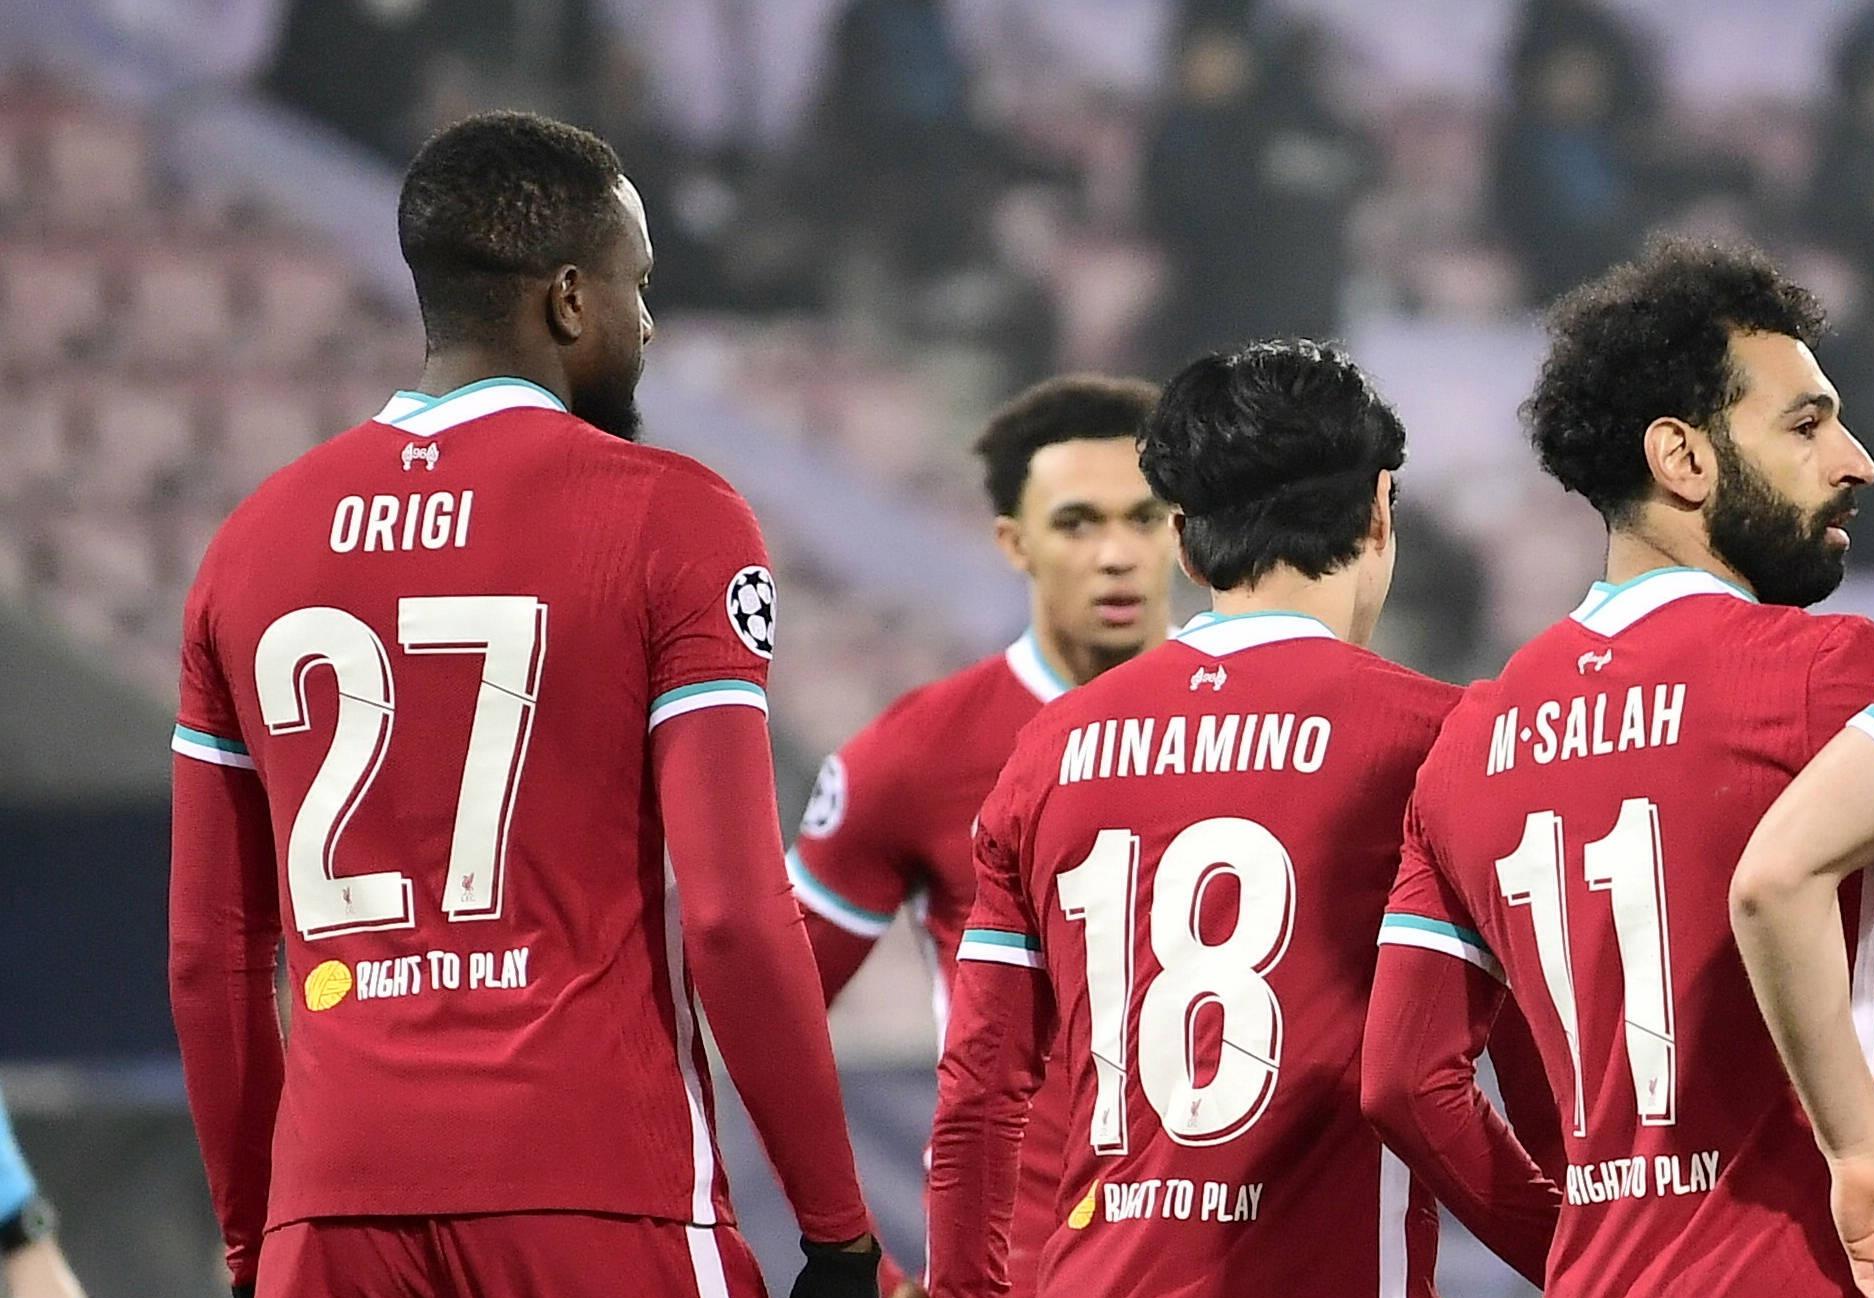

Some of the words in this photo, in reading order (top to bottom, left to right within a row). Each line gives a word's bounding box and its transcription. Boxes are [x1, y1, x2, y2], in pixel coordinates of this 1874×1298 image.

[330, 490, 473, 553] ORIGI
[254, 595, 548, 941] 27
[1058, 712, 1331, 785] MINAMINO
[356, 955, 421, 1001] RIGHT
[426, 950, 461, 990] TO
[469, 947, 530, 990] PLAY
[1056, 816, 1297, 1156] 18
[1495, 797, 1676, 1138] 11
[1161, 1179, 1194, 1219] TO
[1201, 1181, 1264, 1222] PLAY
[1654, 1150, 1720, 1197] PLAY
